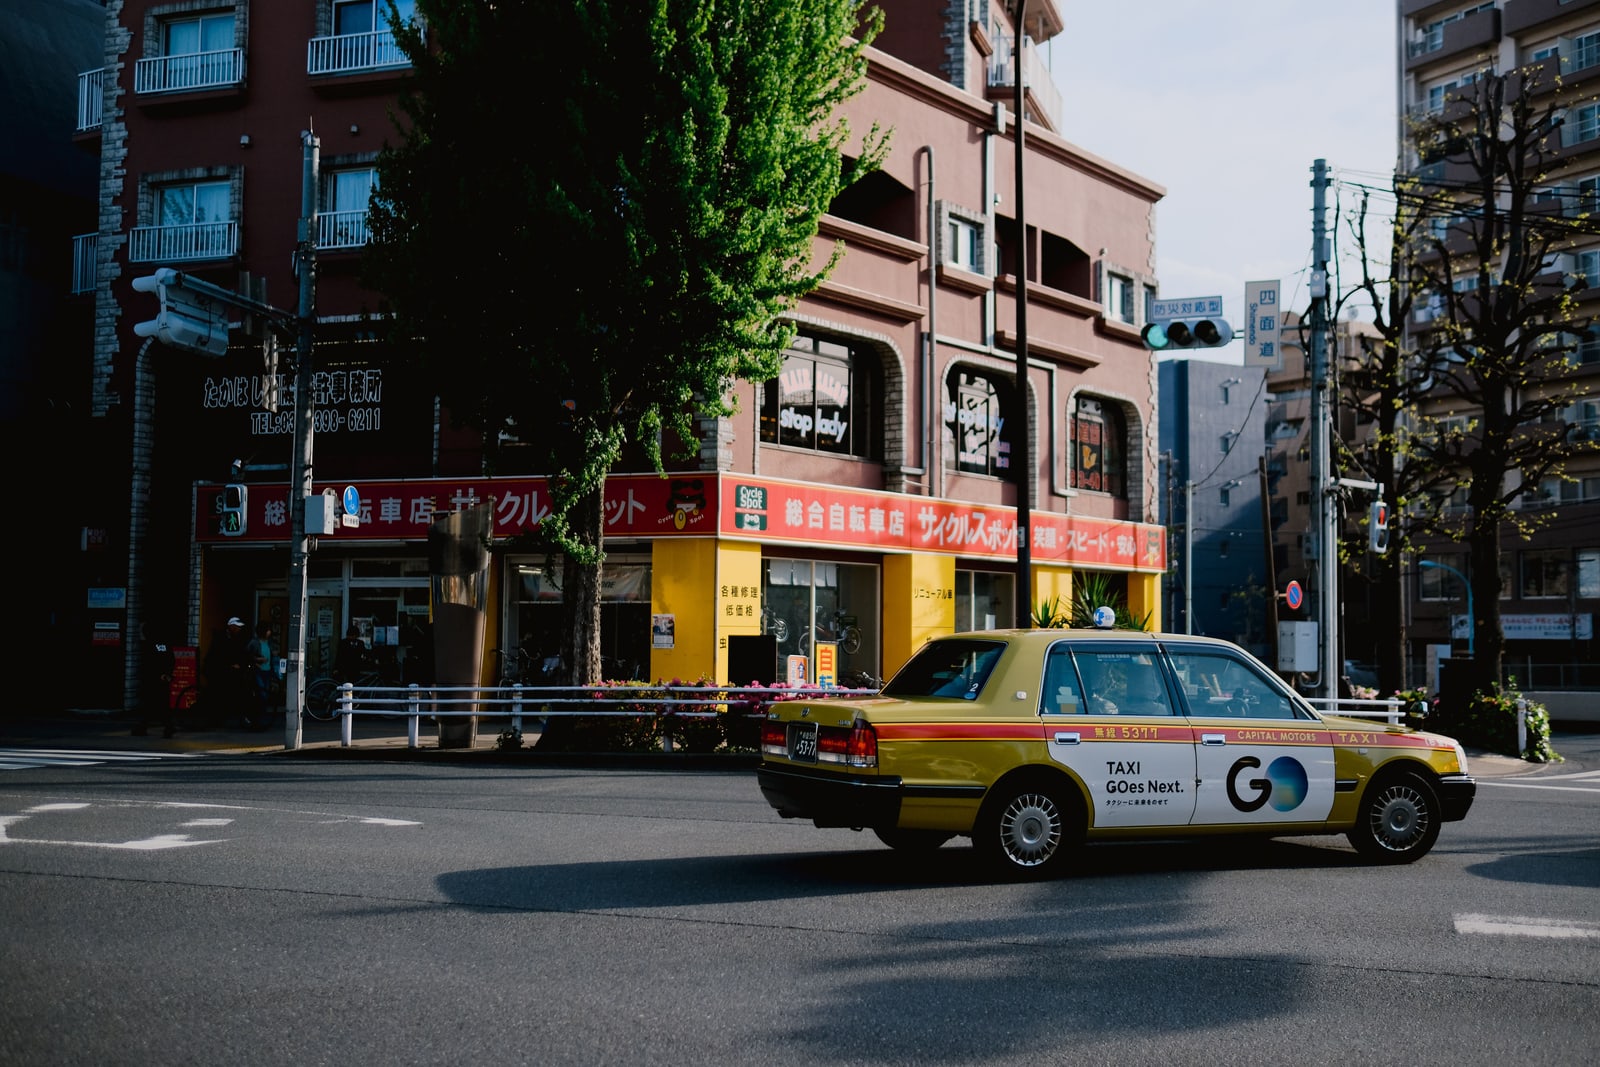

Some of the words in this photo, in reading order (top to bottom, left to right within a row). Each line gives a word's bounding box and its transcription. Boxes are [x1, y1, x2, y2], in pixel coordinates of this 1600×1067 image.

[1154, 301, 1220, 315] 防災対応型
[1249, 303, 1258, 345] Shimendo
[1260, 290, 1276, 358] 四面道
[780, 406, 814, 438] stop
[816, 408, 848, 443] lady
[740, 487, 763, 503] Cycle
[740, 497, 763, 510] Spot
[785, 497, 905, 537] 総合自転車店
[721, 585, 759, 599] 各種修理
[726, 604, 754, 617] 低価格
[969, 683, 979, 692] 2
[1094, 727, 1116, 738] 無線
[1122, 727, 1159, 739] 5377
[1237, 730, 1277, 743] CAPITAL
[1280, 732, 1316, 743] MOTORS
[1339, 732, 1378, 744] TAXI
[1106, 761, 1140, 775] TAXI
[1106, 780, 1145, 794] GOes
[1147, 779, 1184, 794] Next.
[1226, 756, 1309, 813] GO
